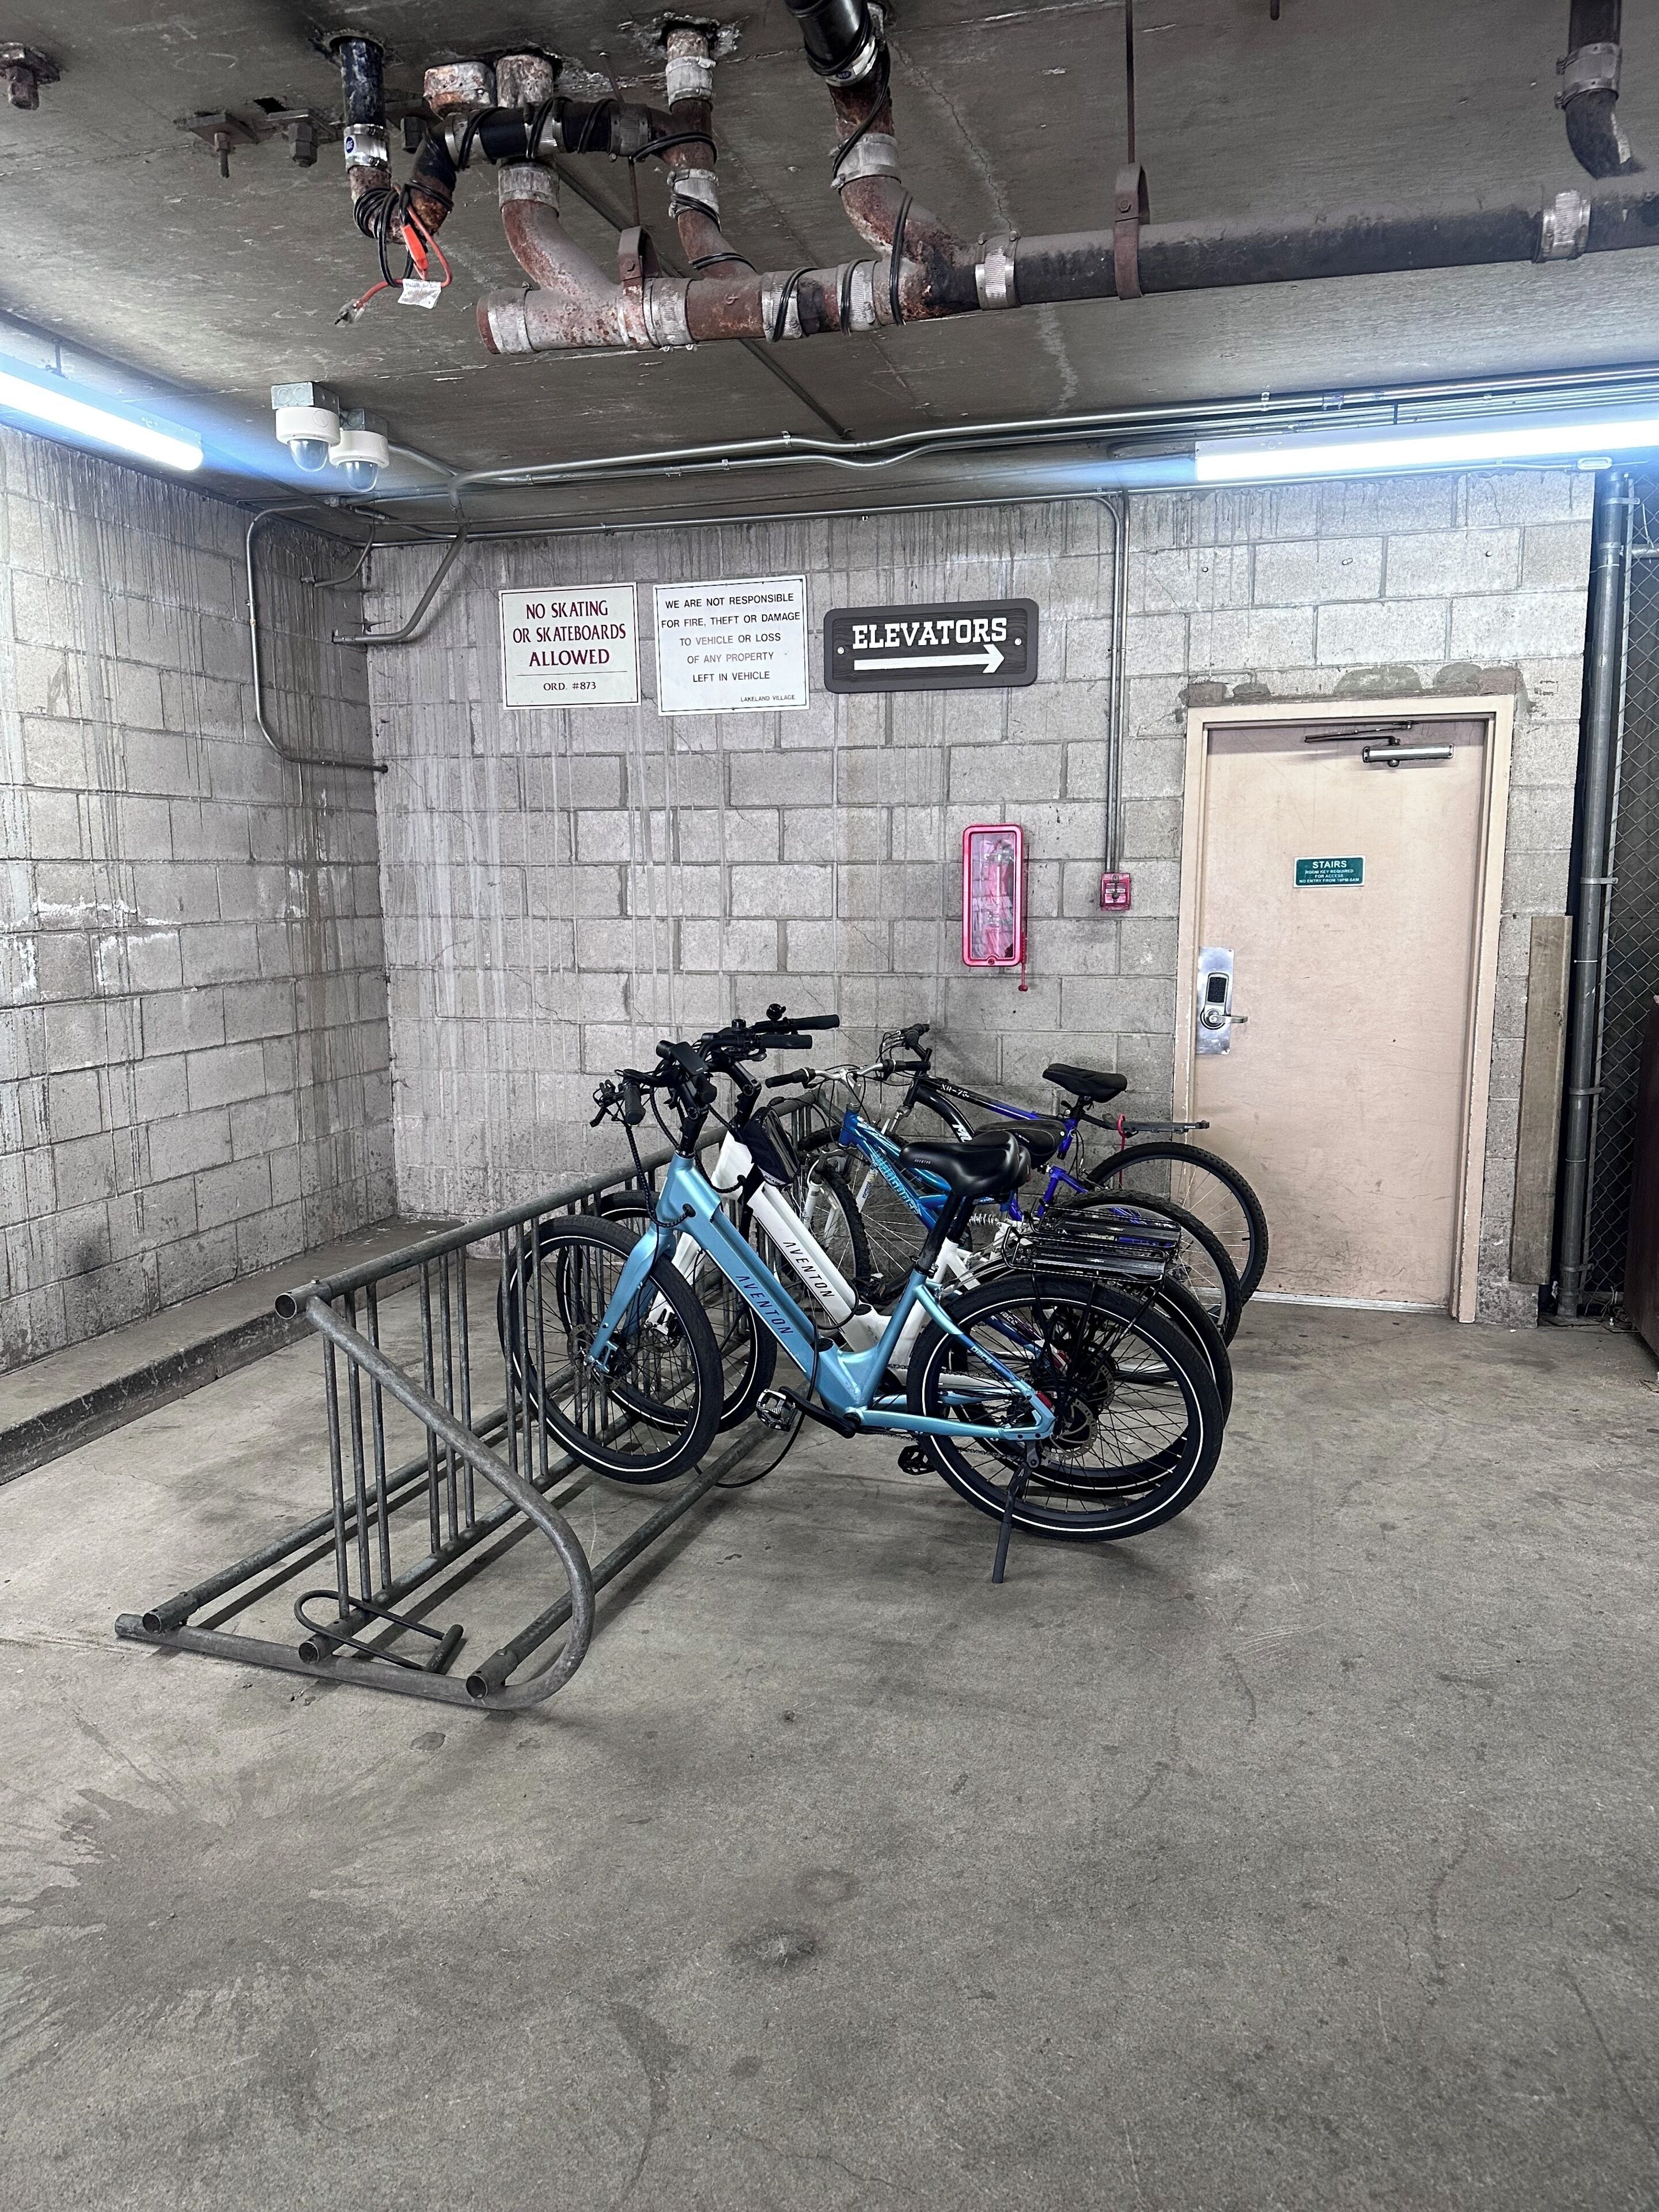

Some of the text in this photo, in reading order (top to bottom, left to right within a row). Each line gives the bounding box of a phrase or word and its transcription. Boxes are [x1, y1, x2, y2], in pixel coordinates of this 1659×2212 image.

[665, 593, 794, 609] WE ARE NOT RESPONSIBLE
[526, 600, 608, 619] NO SKATING
[661, 612, 800, 628] FOR FIRE, THEFT OR DAMAGE
[513, 623, 626, 643] OR SKATEBOARDS
[679, 632, 781, 646] TO VEHICLE OR LOSS
[852, 618, 1007, 650] ELEVATORS
[529, 649, 609, 667] ALLOWED
[687, 652, 774, 664] OF ANY PROPERTY
[693, 671, 770, 683] LEFT IN VEHICLE
[543, 681, 596, 691] ORD. #873
[1312, 860, 1347, 869] STAIRS
[783, 1241, 835, 1298] AVENTON
[736, 1275, 794, 1335] AVENTON
[1000, 1312, 1018, 1325] ace
[971, 1345, 994, 1365] pace
